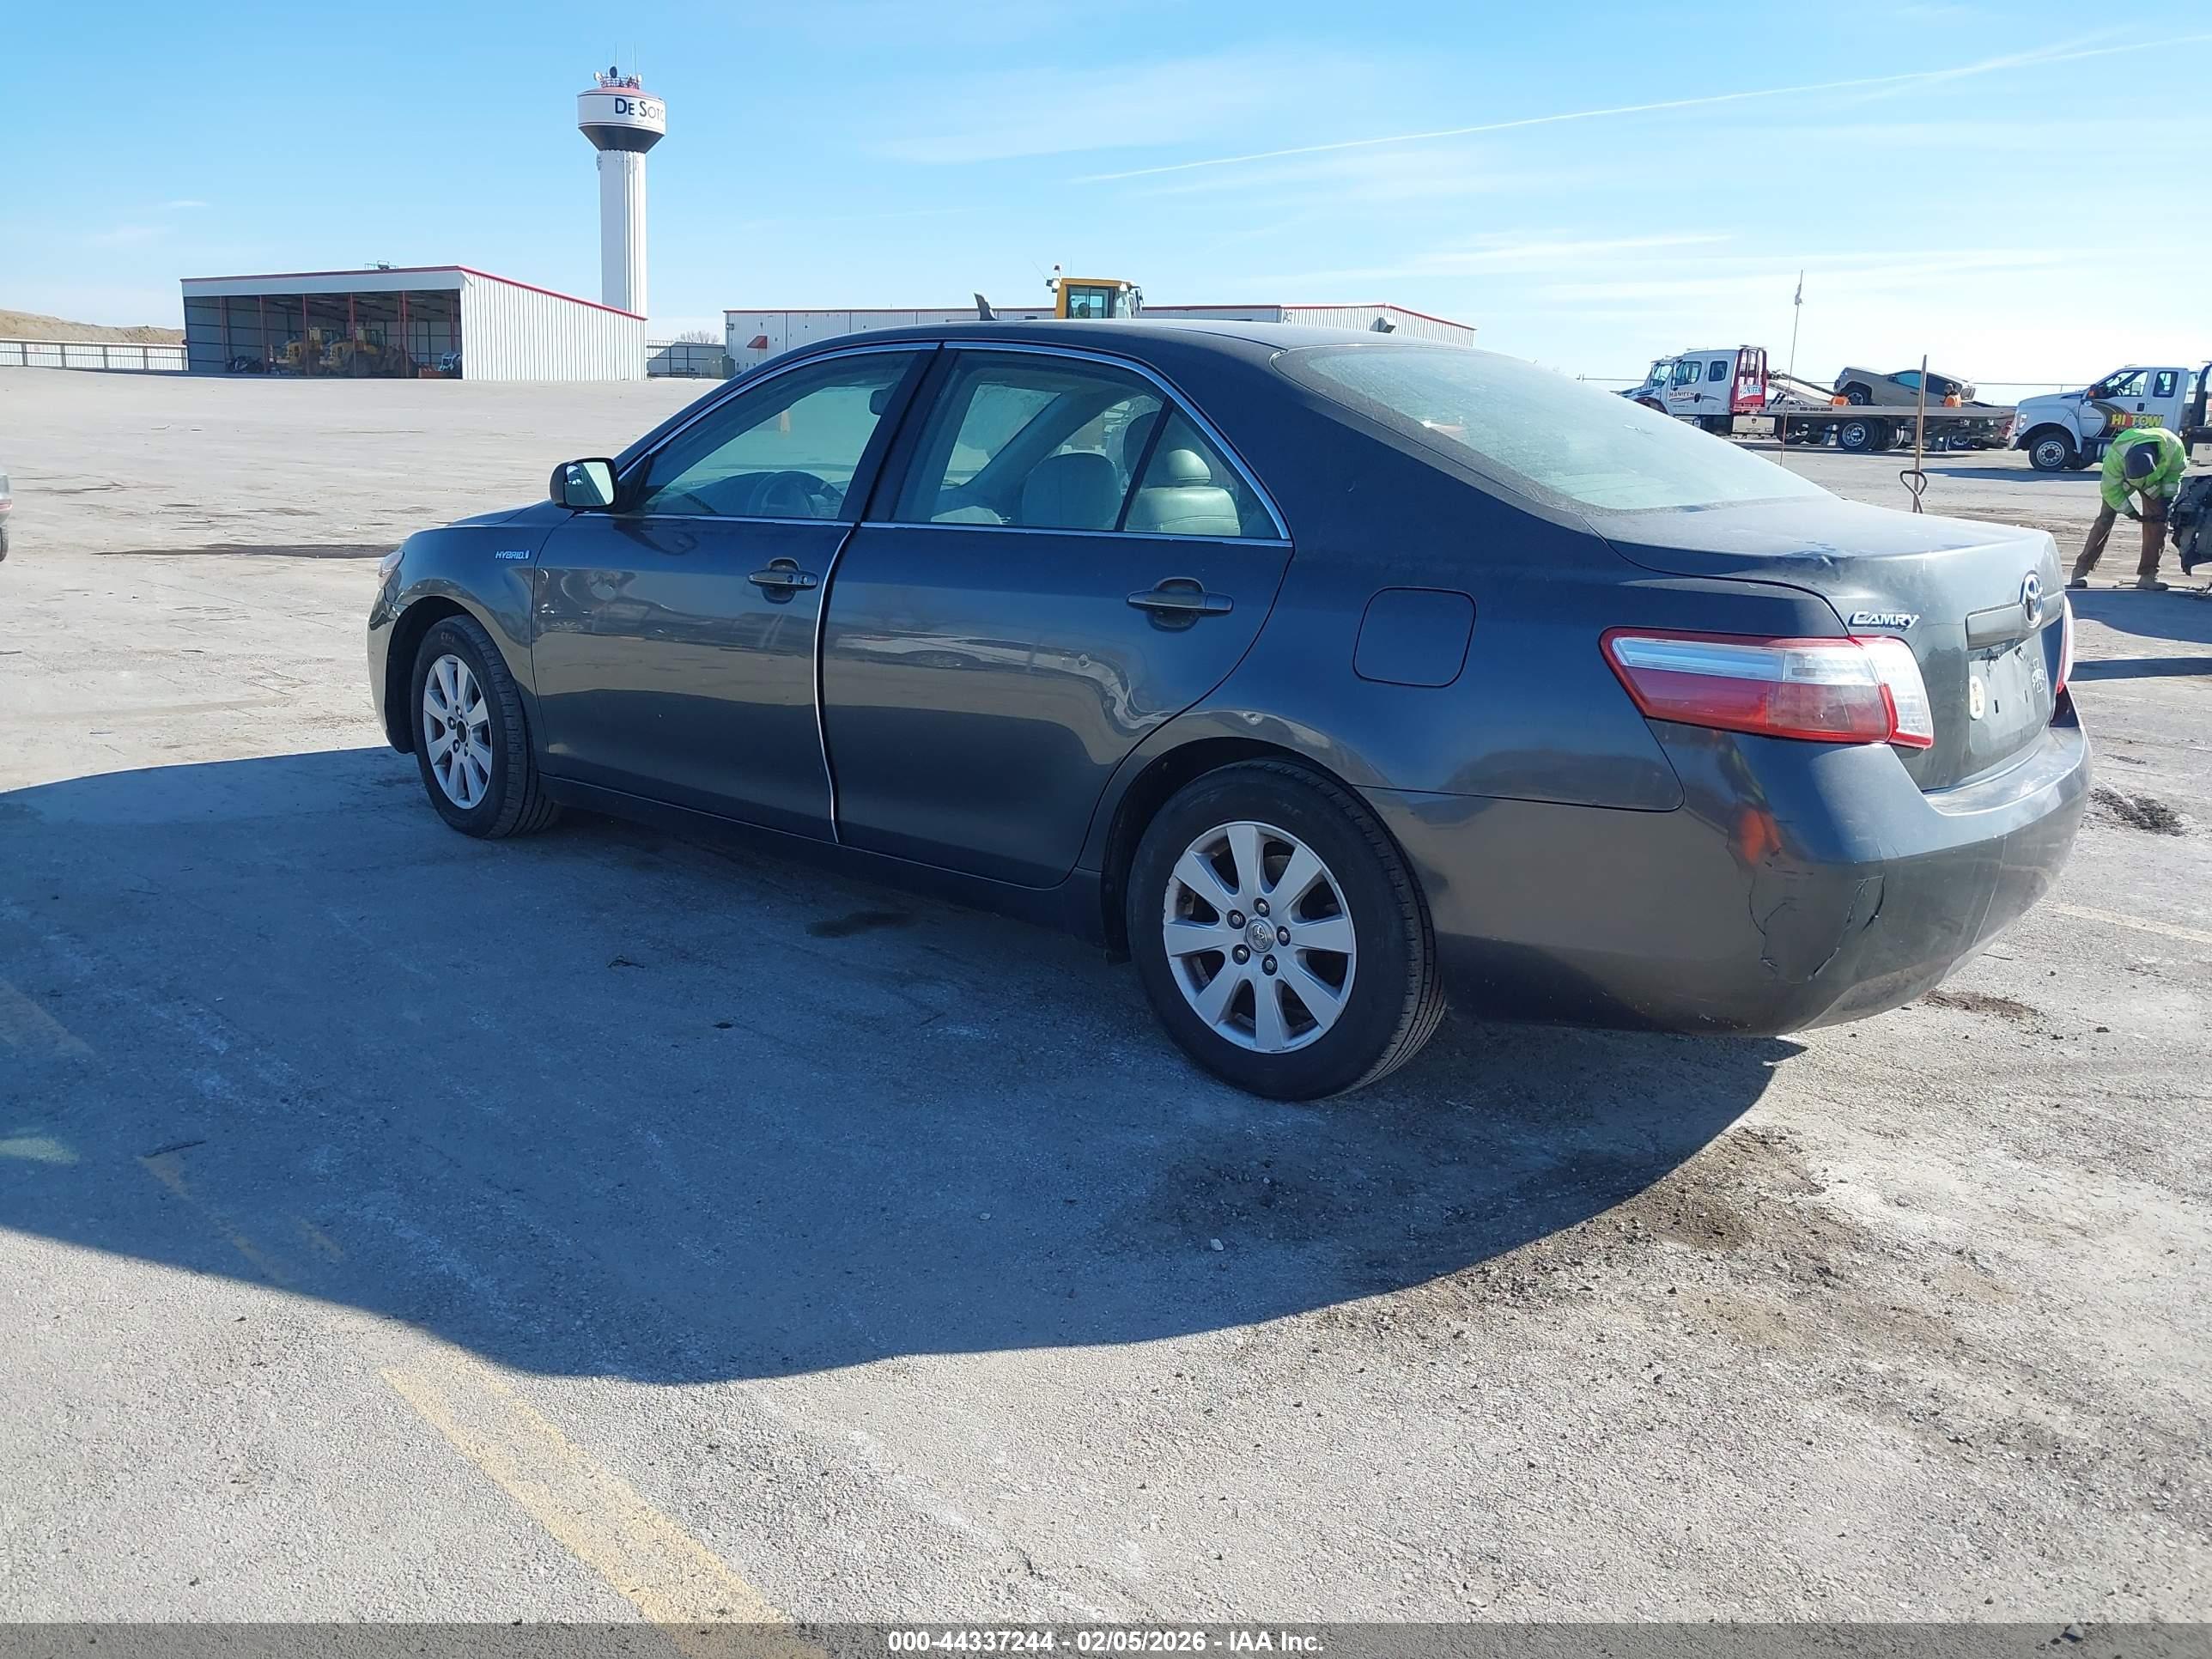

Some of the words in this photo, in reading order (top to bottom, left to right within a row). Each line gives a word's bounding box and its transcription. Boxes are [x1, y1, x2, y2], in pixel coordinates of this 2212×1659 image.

[2112, 414, 2126, 426] HI
[2130, 415, 2163, 427] TOW
[495, 550, 525, 559] HYBRID
[1852, 611, 1919, 629] CAMRY
